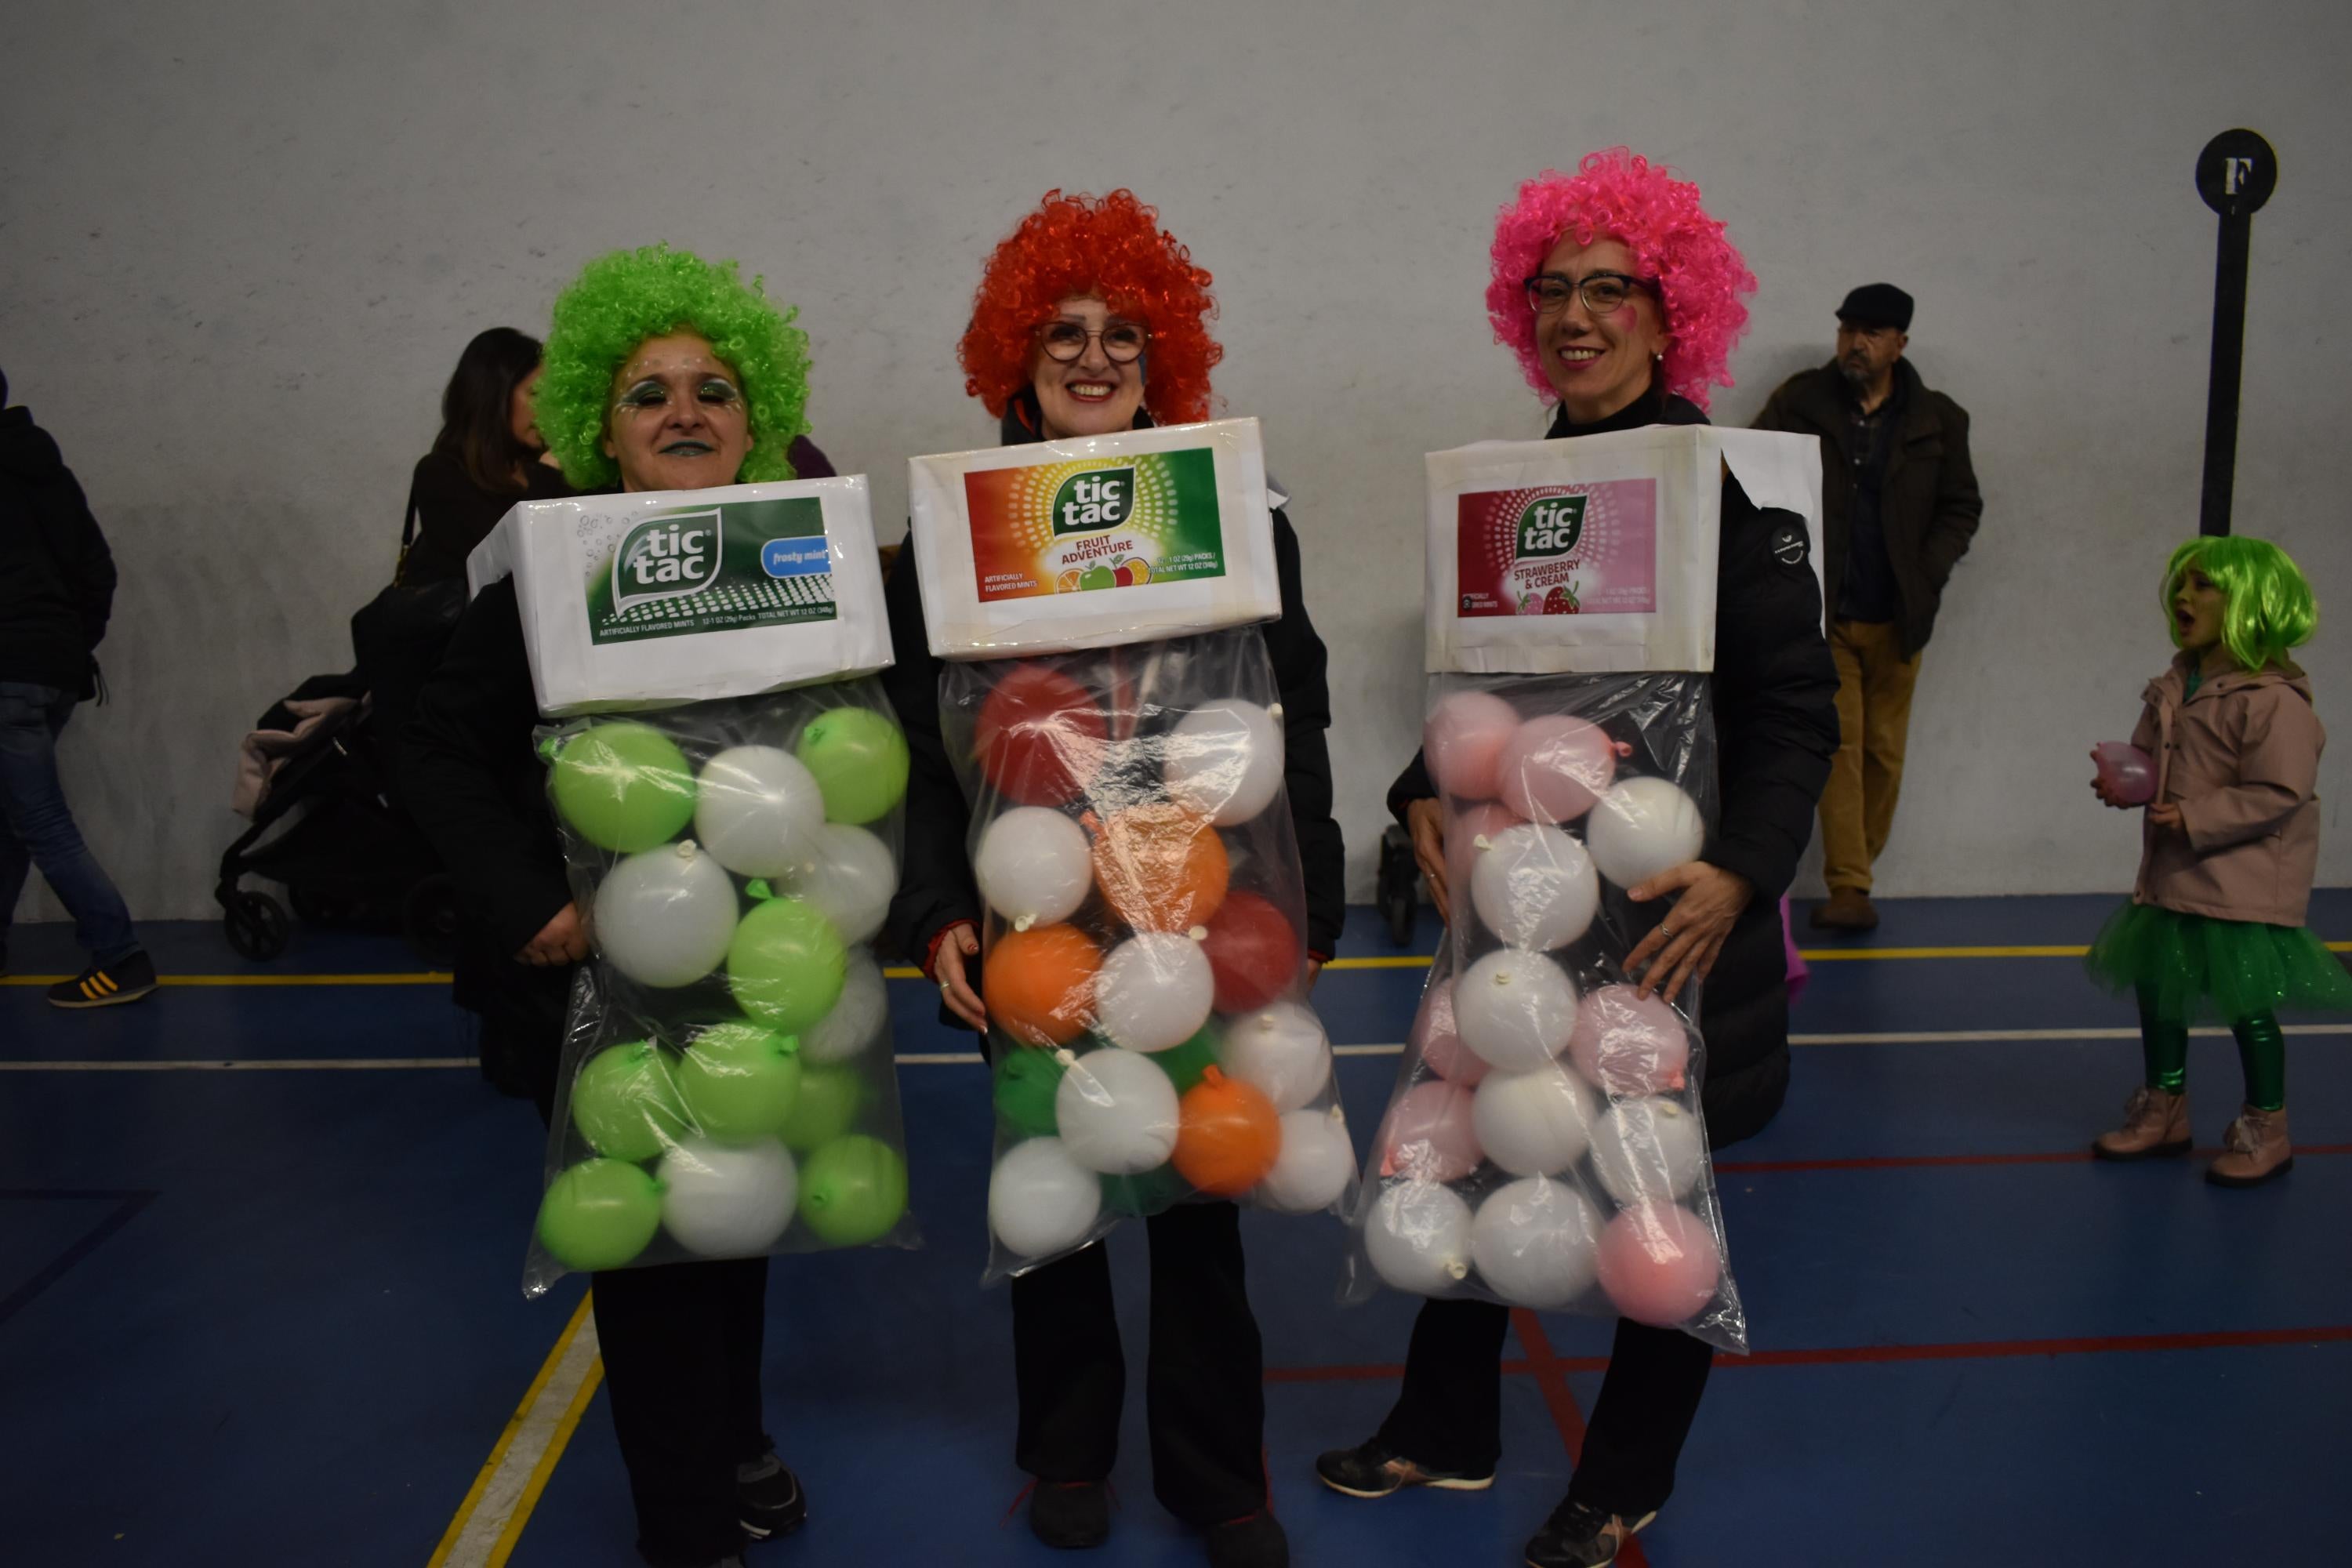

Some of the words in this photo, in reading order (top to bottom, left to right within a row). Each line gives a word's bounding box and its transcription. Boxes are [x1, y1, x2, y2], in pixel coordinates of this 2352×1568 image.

[2225, 157, 2252, 194] F
[1073, 476, 1120, 503] tic
[1062, 501, 1120, 525] tac
[1534, 503, 1573, 529] tic
[646, 524, 704, 557] tic
[1076, 535, 1110, 550] FRUIT
[1524, 527, 1570, 550] tac
[773, 552, 803, 565] frosty
[804, 550, 826, 561] mint
[1062, 539, 1134, 564] ADVENTURE
[633, 556, 704, 584] tac
[985, 572, 1023, 583] ARTIFICIALLY
[1515, 559, 1580, 581] STRAWBERRY
[1525, 579, 1533, 590] &
[1535, 572, 1569, 587] CREAM
[985, 583, 1016, 592] FLAVORED
[600, 626, 641, 637] ARTIFICIALLY
[641, 622, 673, 632] FLAVORED
[673, 619, 695, 628] MINTS
